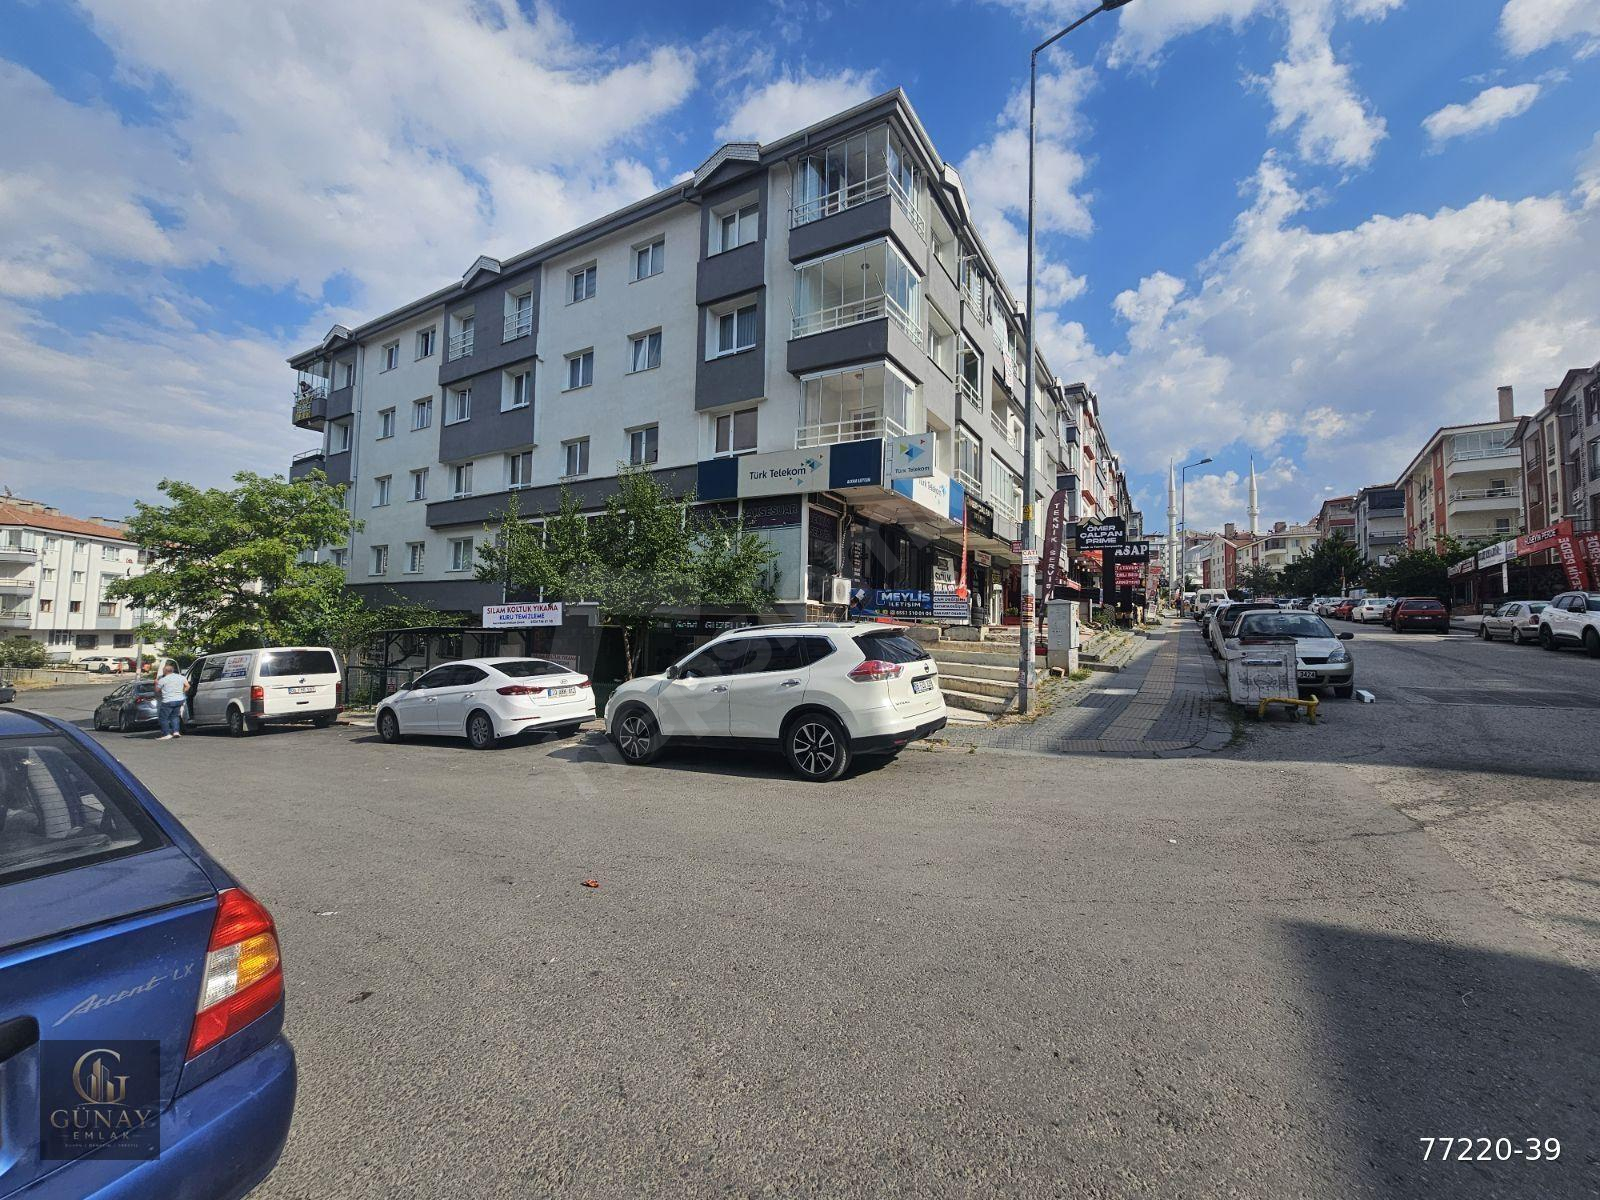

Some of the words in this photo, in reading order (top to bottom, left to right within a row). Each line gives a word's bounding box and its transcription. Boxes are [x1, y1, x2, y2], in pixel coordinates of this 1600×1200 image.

[749, 468, 768, 480] Türk
[770, 466, 807, 479] Telekom
[907, 465, 930, 473] Telekom
[1079, 531, 1123, 539] ÇALPAN
[1114, 544, 1148, 556] ASAP
[881, 590, 931, 602] MEYLİS
[507, 605, 532, 613] KOLTUK
[533, 603, 558, 612] YIKAMA
[52, 975, 168, 1027] Accent
[173, 962, 195, 981] LX
